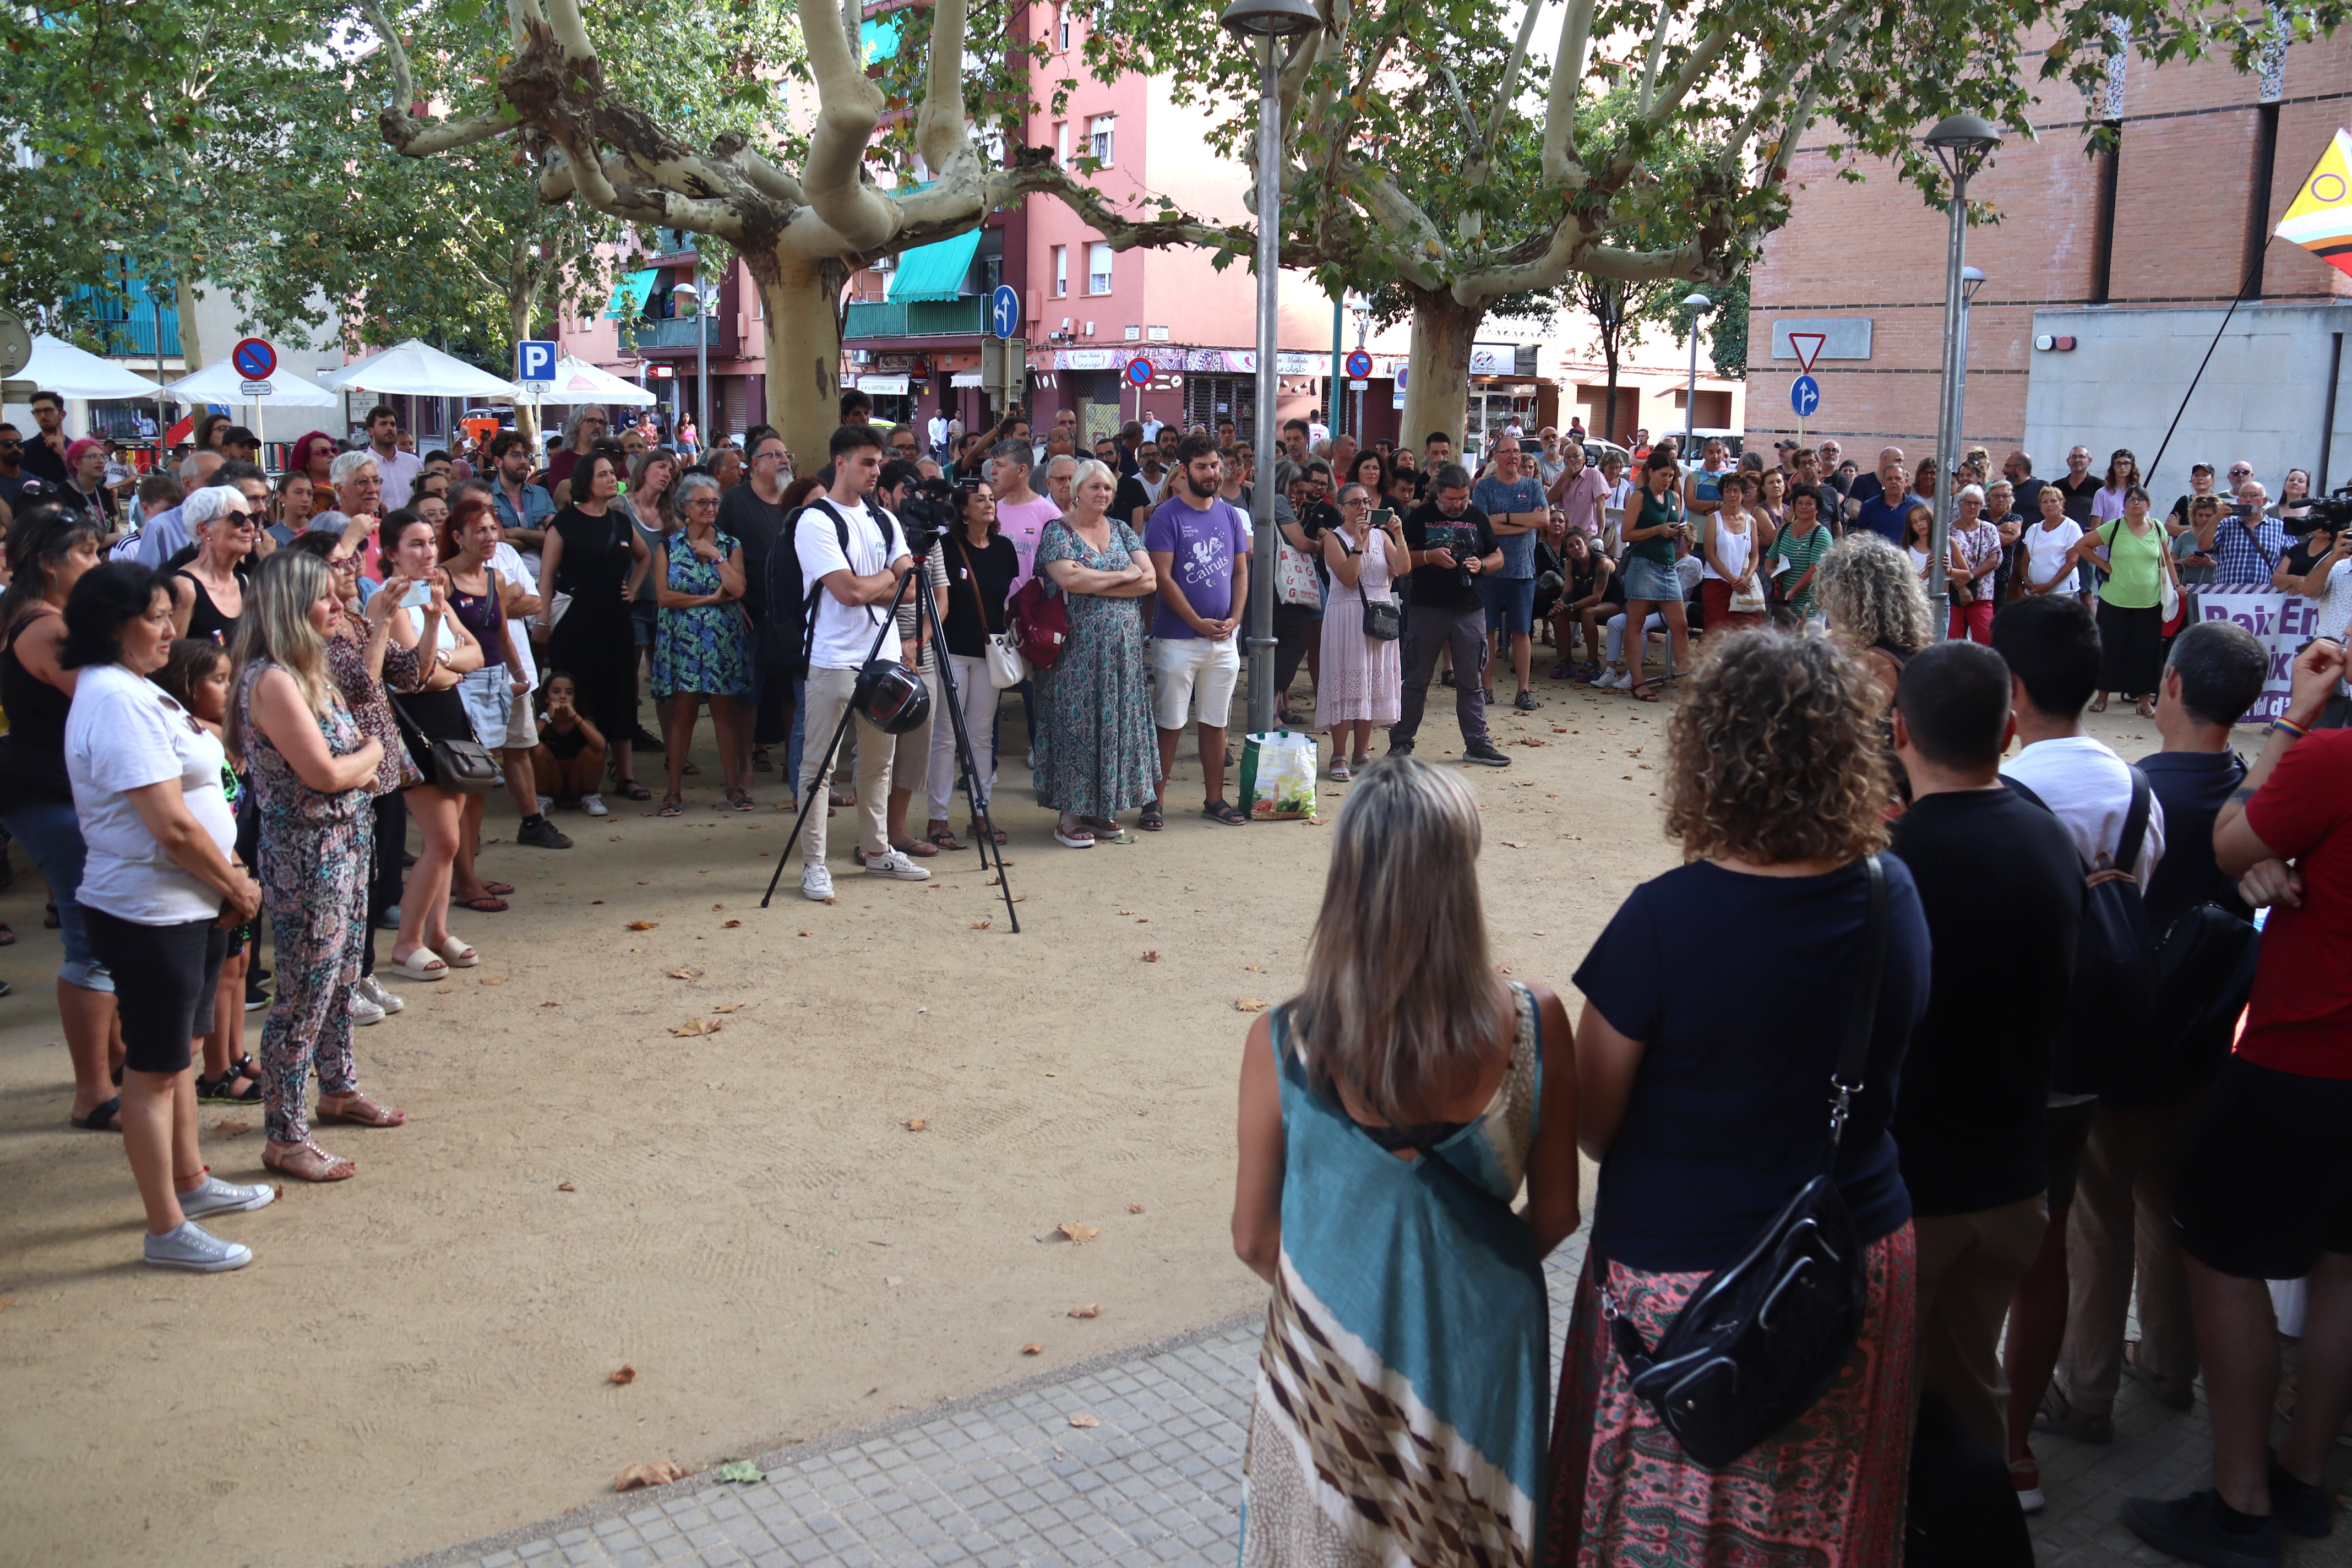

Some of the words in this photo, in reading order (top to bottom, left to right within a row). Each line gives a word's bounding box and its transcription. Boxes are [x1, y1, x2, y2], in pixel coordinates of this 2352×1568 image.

[526, 346, 548, 376] P
[1284, 355, 1308, 364] Marhaba
[1186, 556, 1228, 583] Cairuts
[1289, 587, 1296, 598] G
